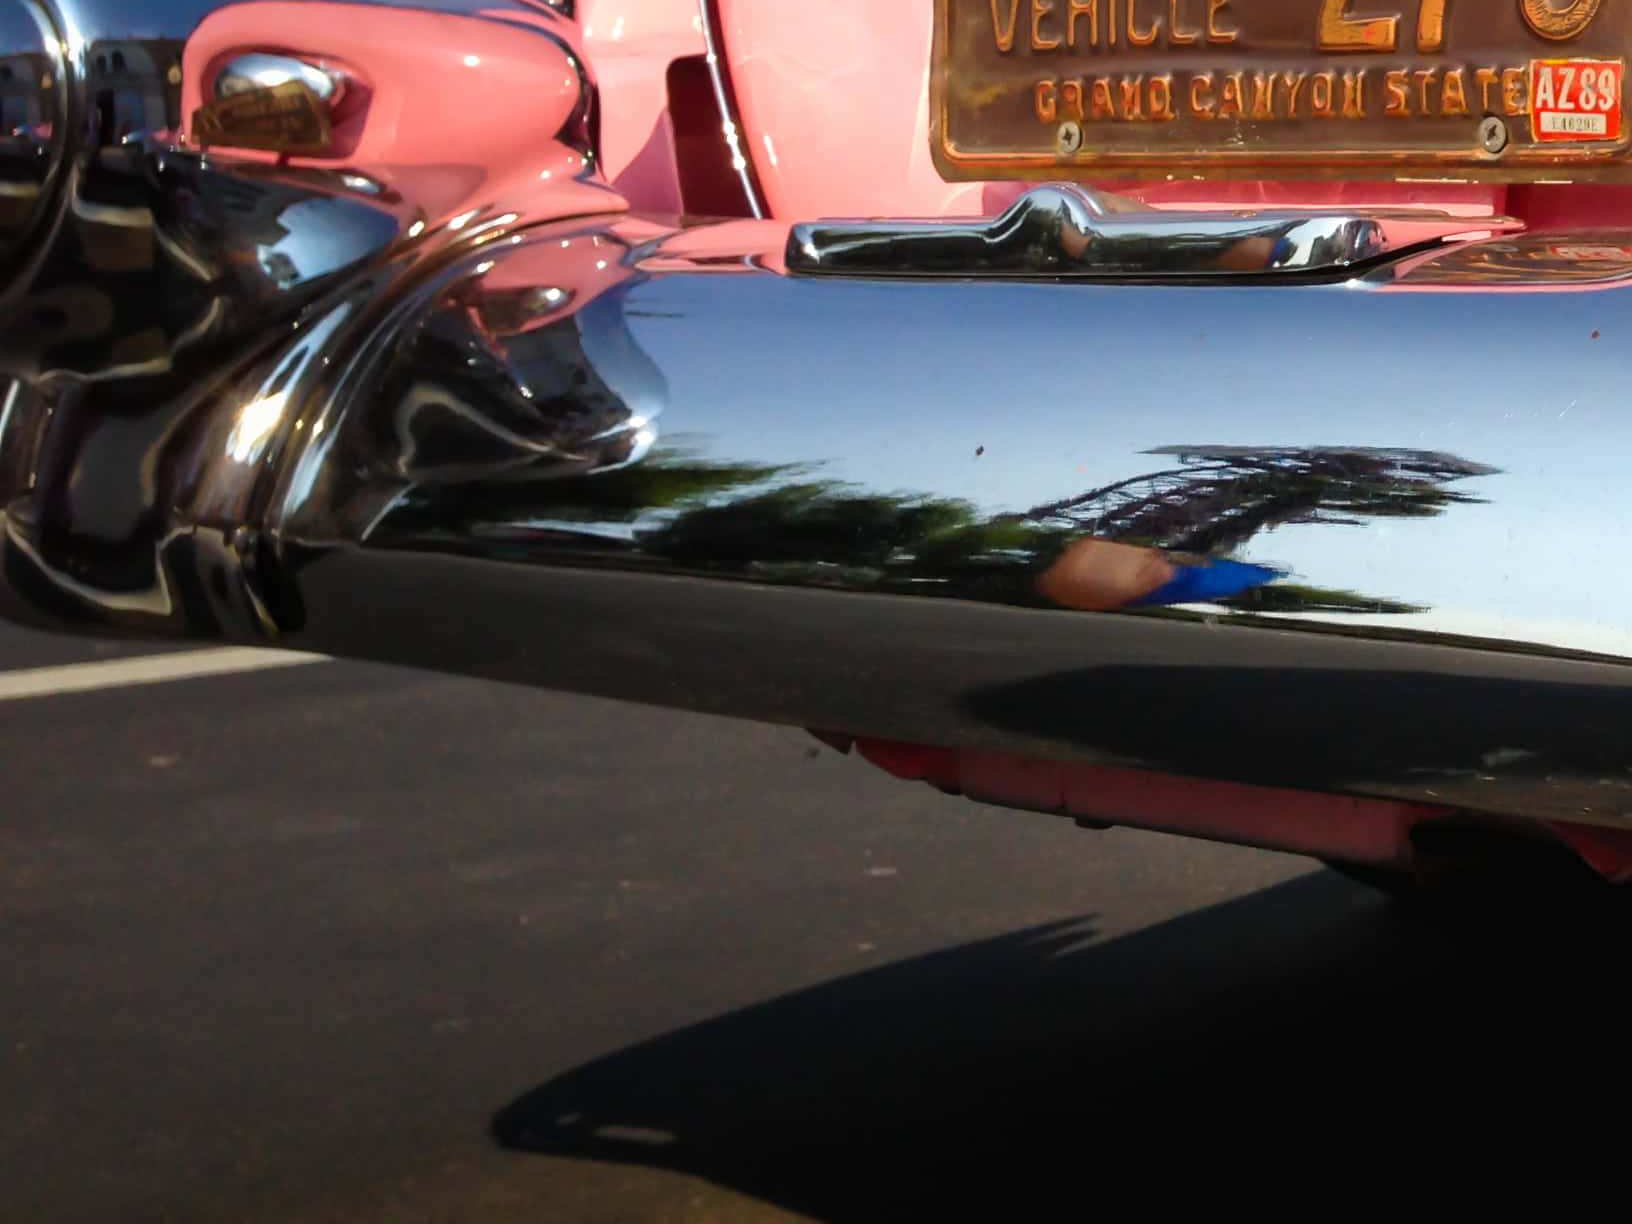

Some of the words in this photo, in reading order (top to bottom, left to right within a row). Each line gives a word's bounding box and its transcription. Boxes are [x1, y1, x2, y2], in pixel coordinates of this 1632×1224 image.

[1034, 74, 1176, 122] GRAND
[1189, 68, 1367, 121] CANYON
[1384, 66, 1529, 117] STATE
